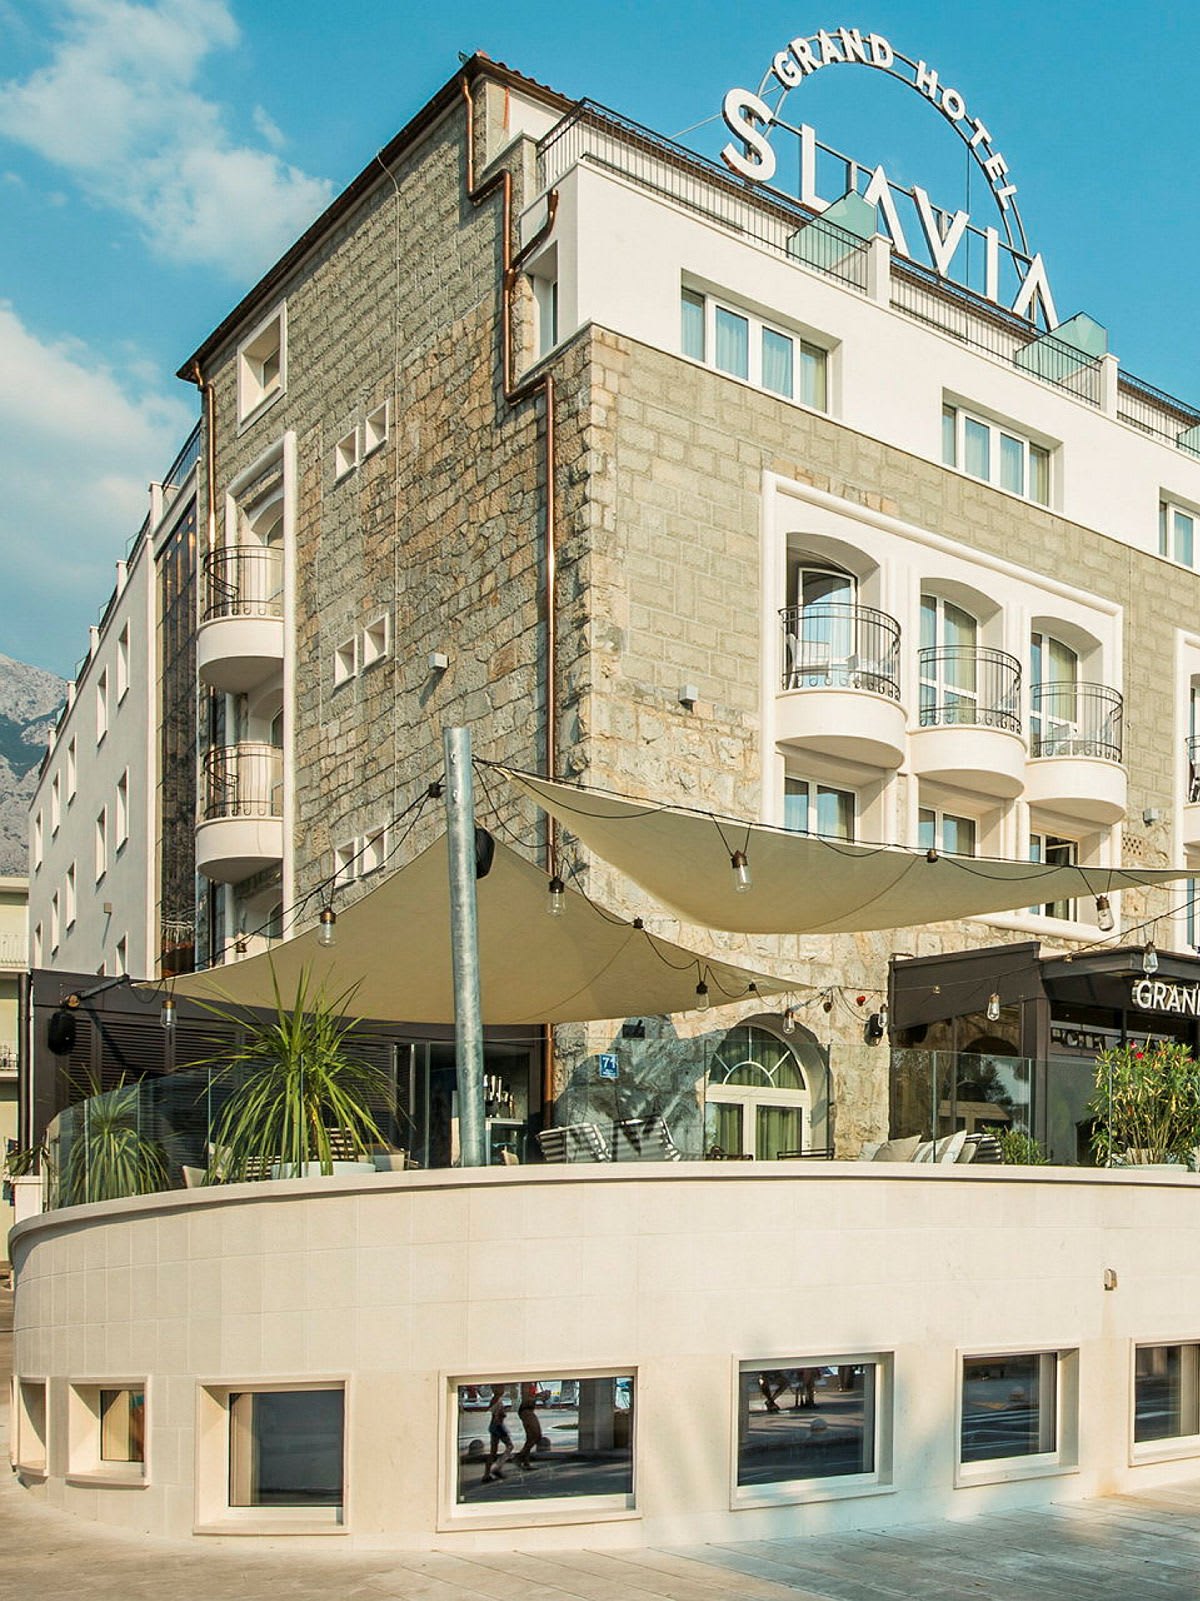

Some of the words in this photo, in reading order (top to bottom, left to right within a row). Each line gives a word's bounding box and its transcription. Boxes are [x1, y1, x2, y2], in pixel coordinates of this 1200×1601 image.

[720, 88, 1059, 331] SLAVIA
[773, 27, 894, 88] GRAND
[915, 60, 1019, 211] HOTEL
